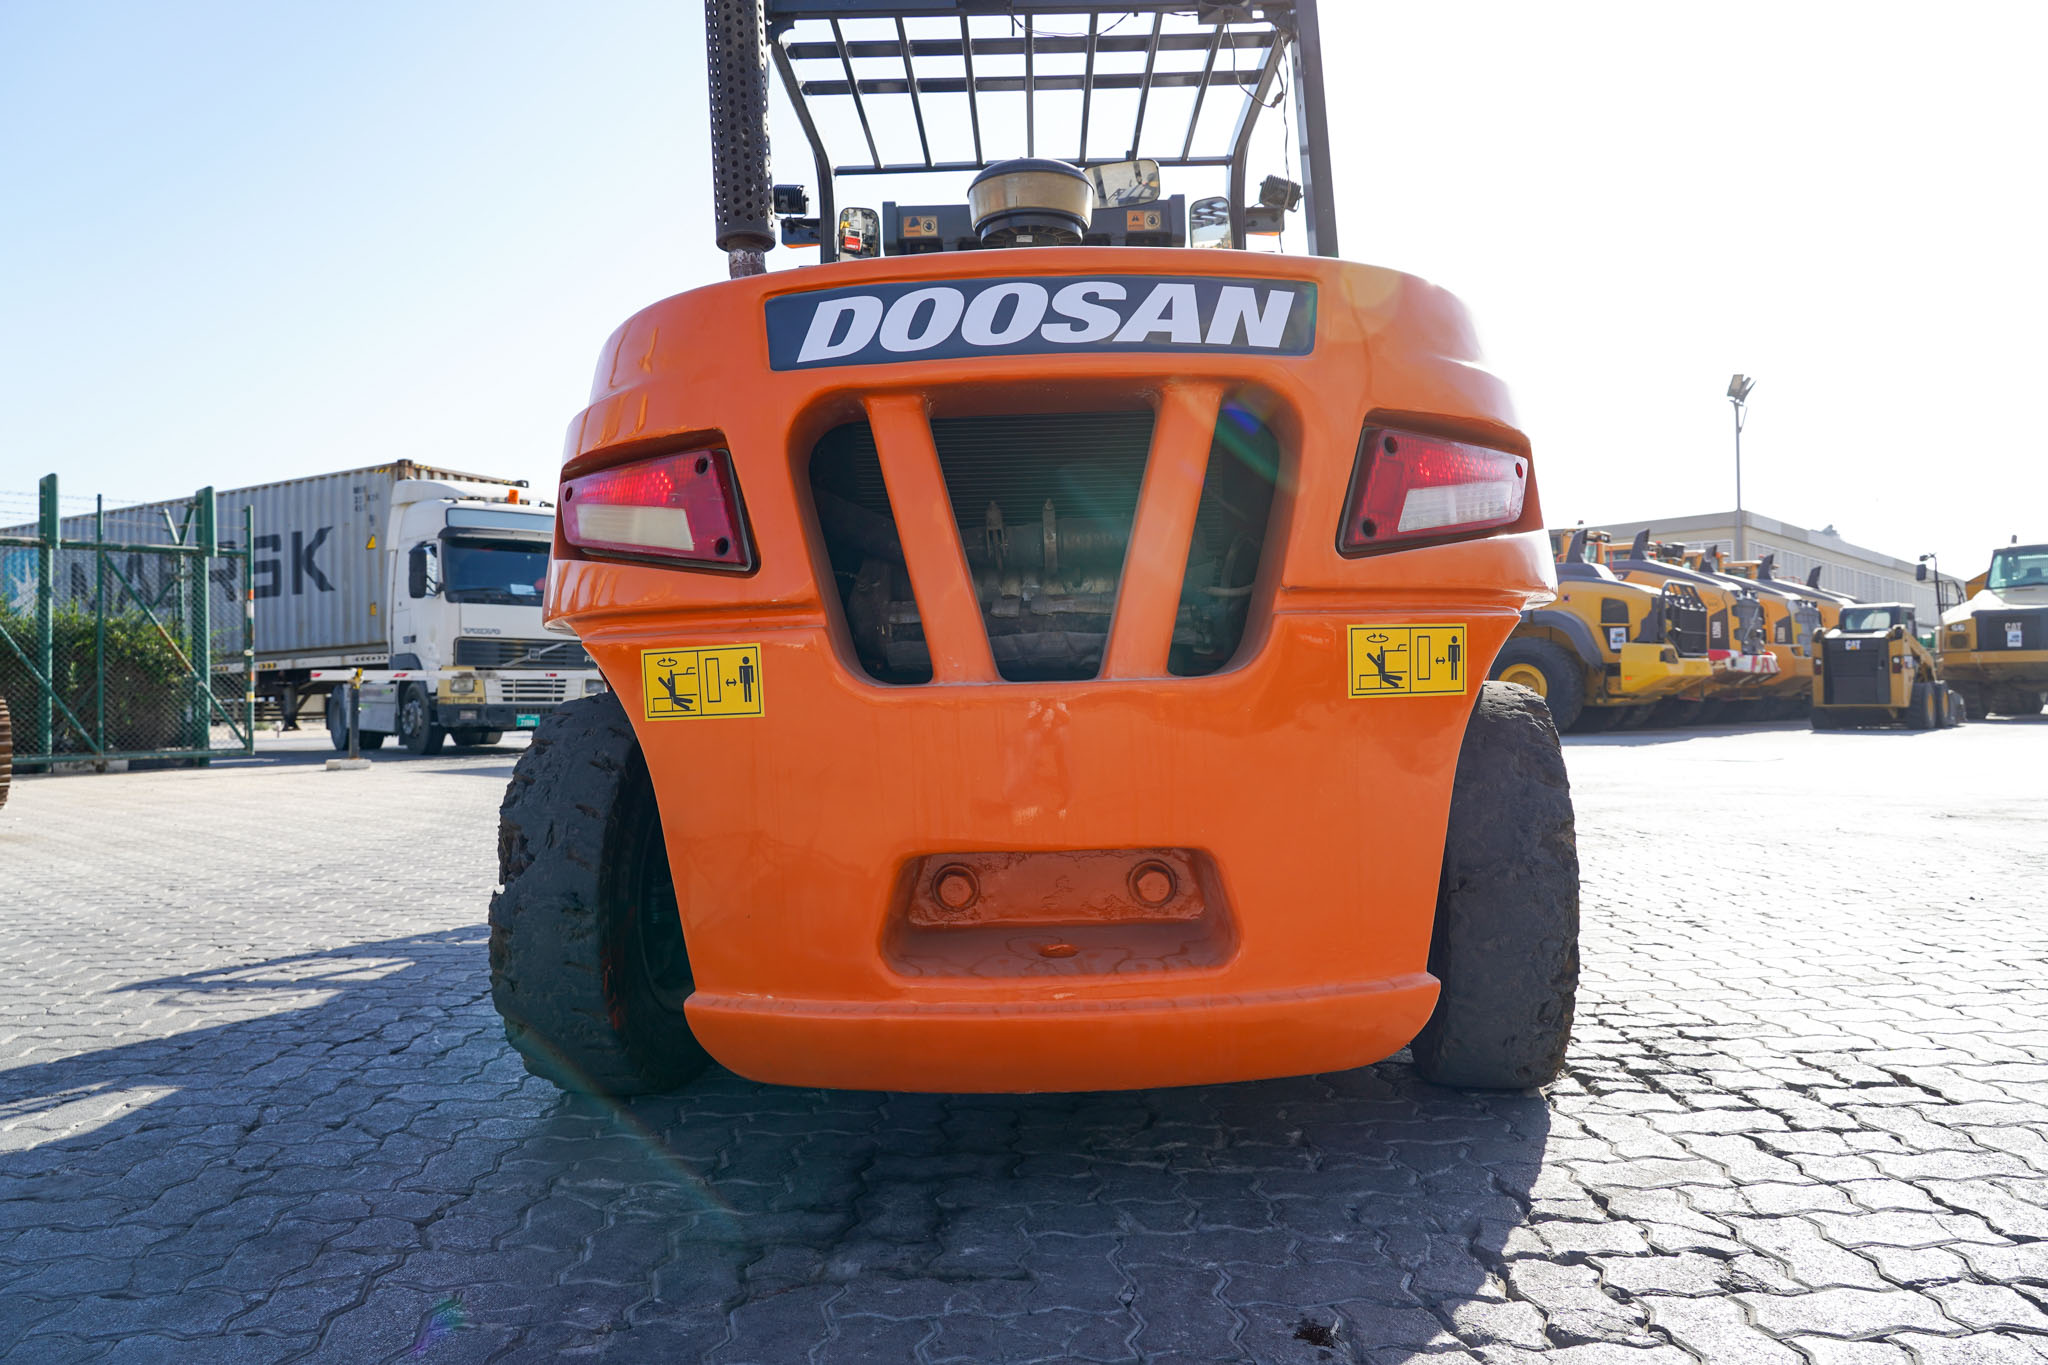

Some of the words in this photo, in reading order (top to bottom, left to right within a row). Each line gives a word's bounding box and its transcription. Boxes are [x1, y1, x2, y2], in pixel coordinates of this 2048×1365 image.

[796, 281, 1295, 363] DOOSAN
[2004, 622, 2023, 632] CAT
[1845, 640, 1862, 650] CAT
